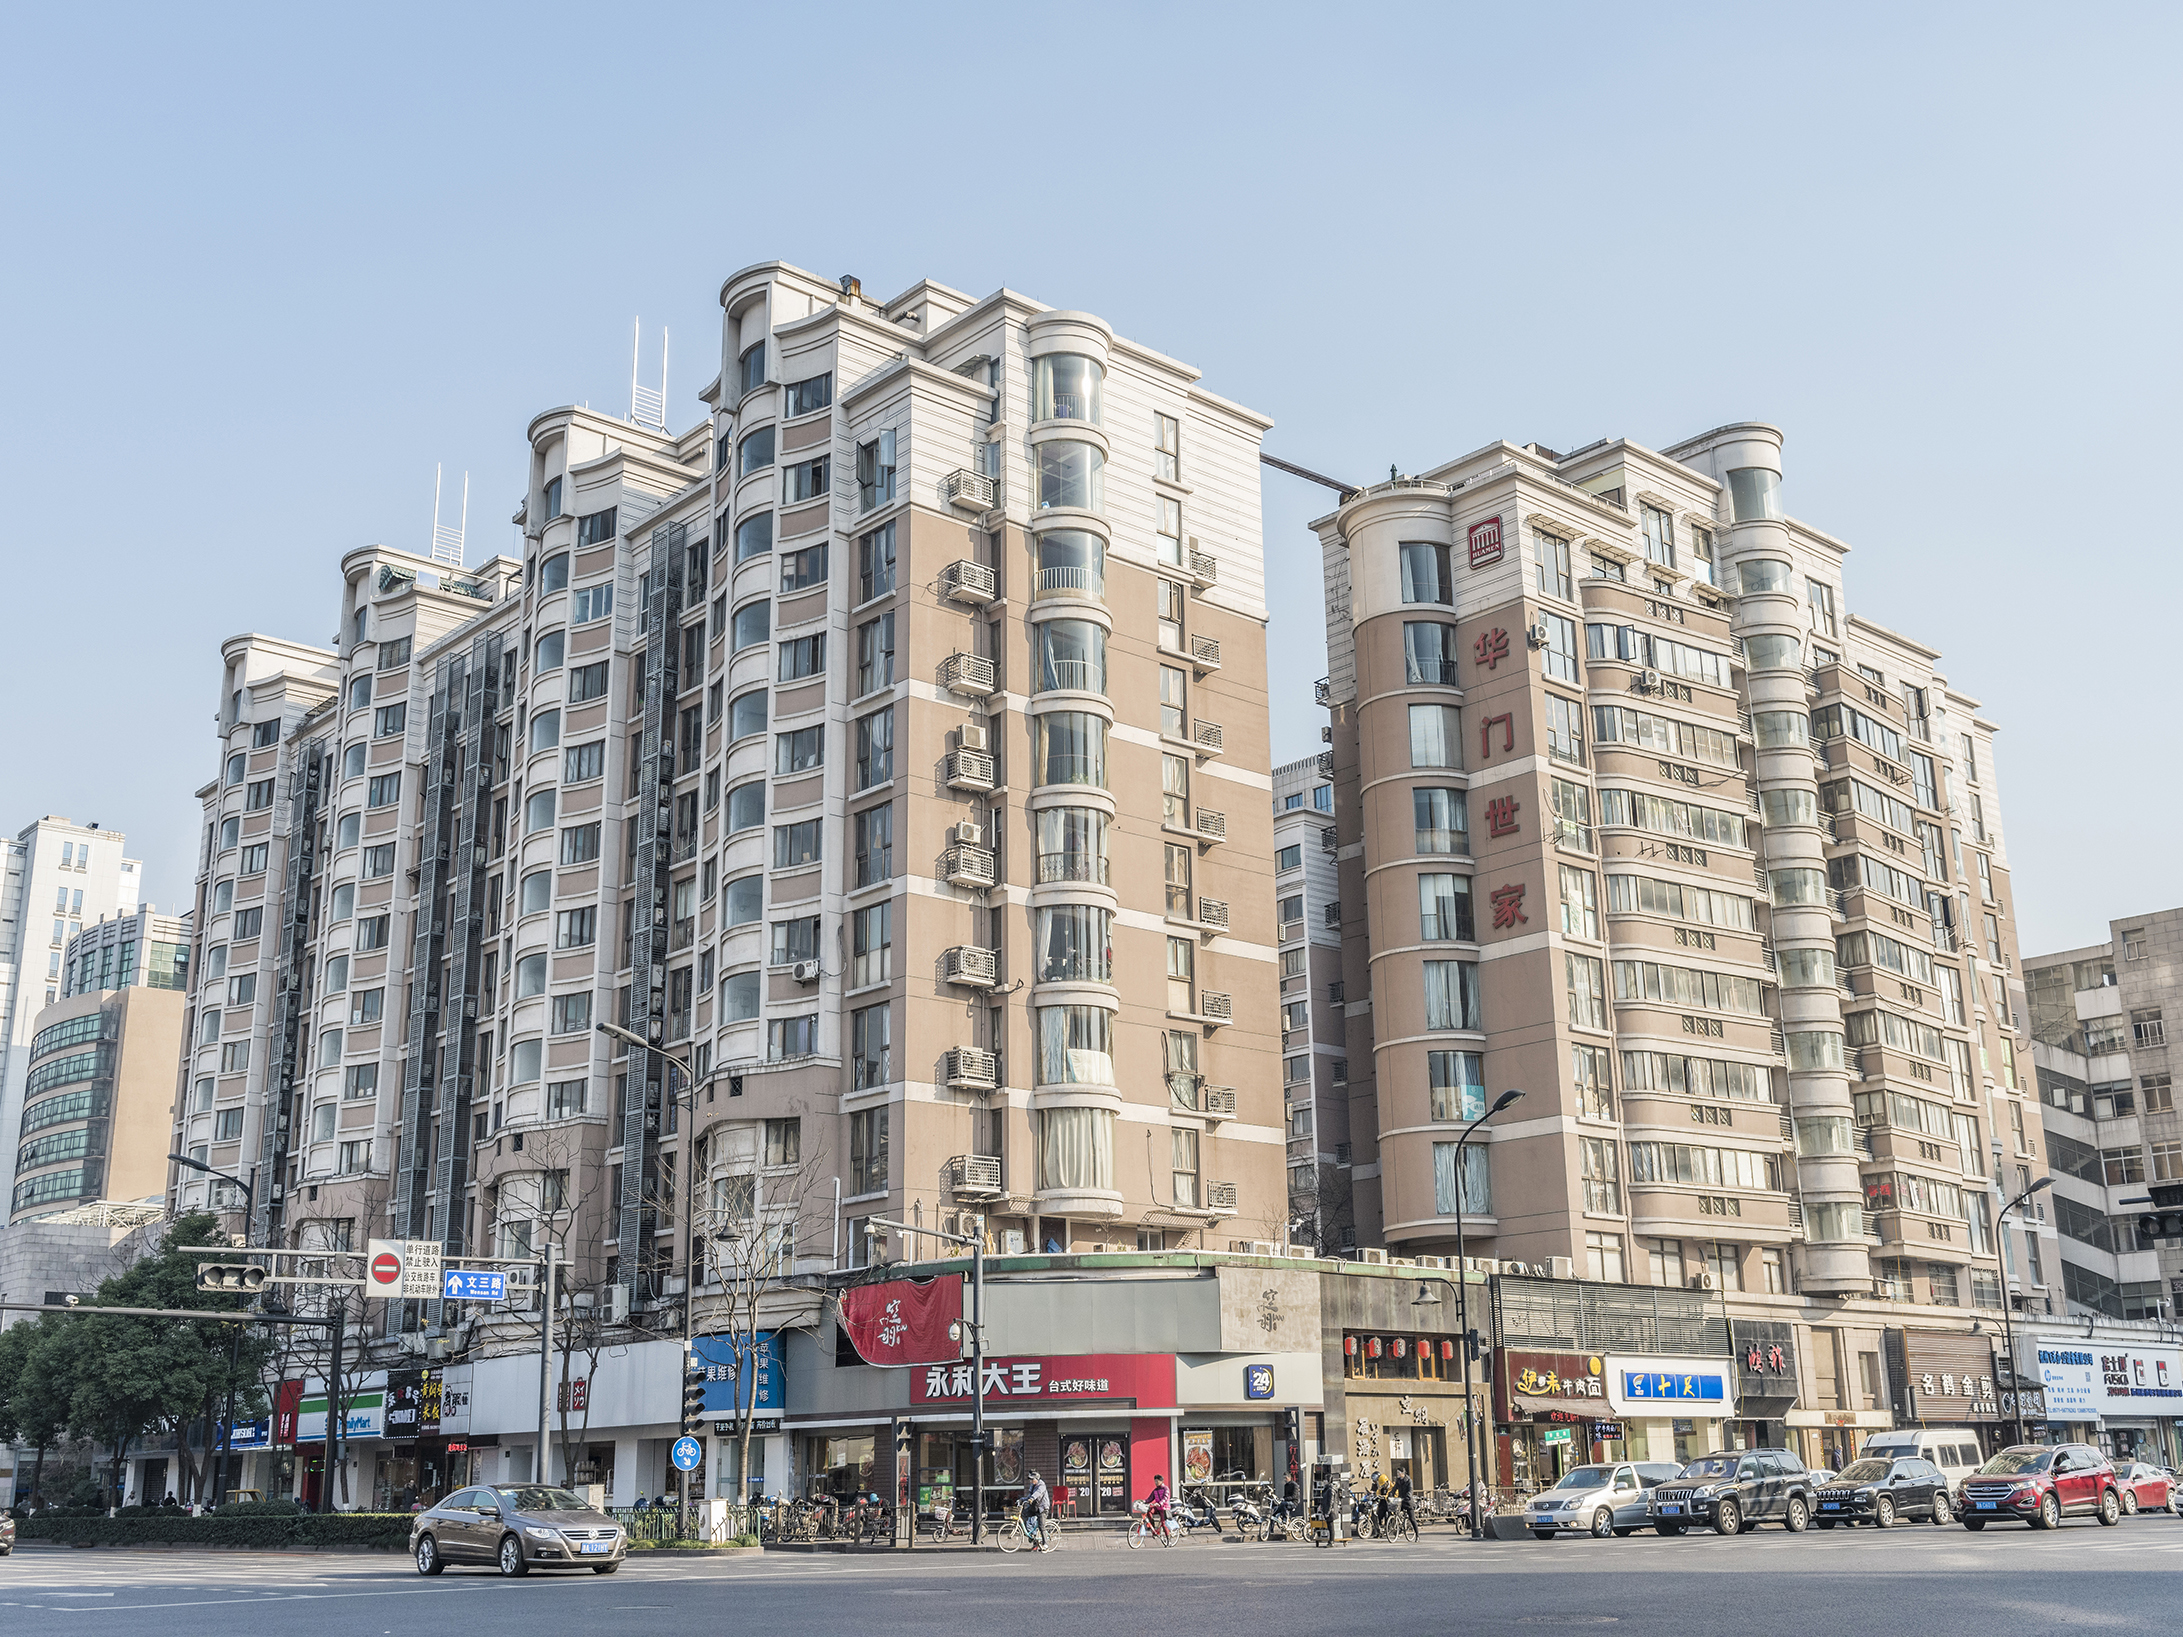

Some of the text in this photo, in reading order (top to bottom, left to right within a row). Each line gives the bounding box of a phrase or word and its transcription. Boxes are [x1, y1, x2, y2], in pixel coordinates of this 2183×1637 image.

[1474, 627, 1529, 929] 华门世家
[406, 1244, 440, 1255] 单行道路
[405, 1257, 439, 1268] 禁止驶入
[403, 1284, 438, 1295] 非机动车除外
[467, 1276, 502, 1290] 文三路
[758, 1343, 769, 1402] 苹果维修
[926, 1363, 1042, 1397] 永和大王
[1253, 1372, 1269, 1387] 24
[1049, 1378, 1109, 1393] 台式好味道
[1657, 1374, 1696, 1398] 十足
[1922, 1373, 1993, 1399] 名鹤金剪
